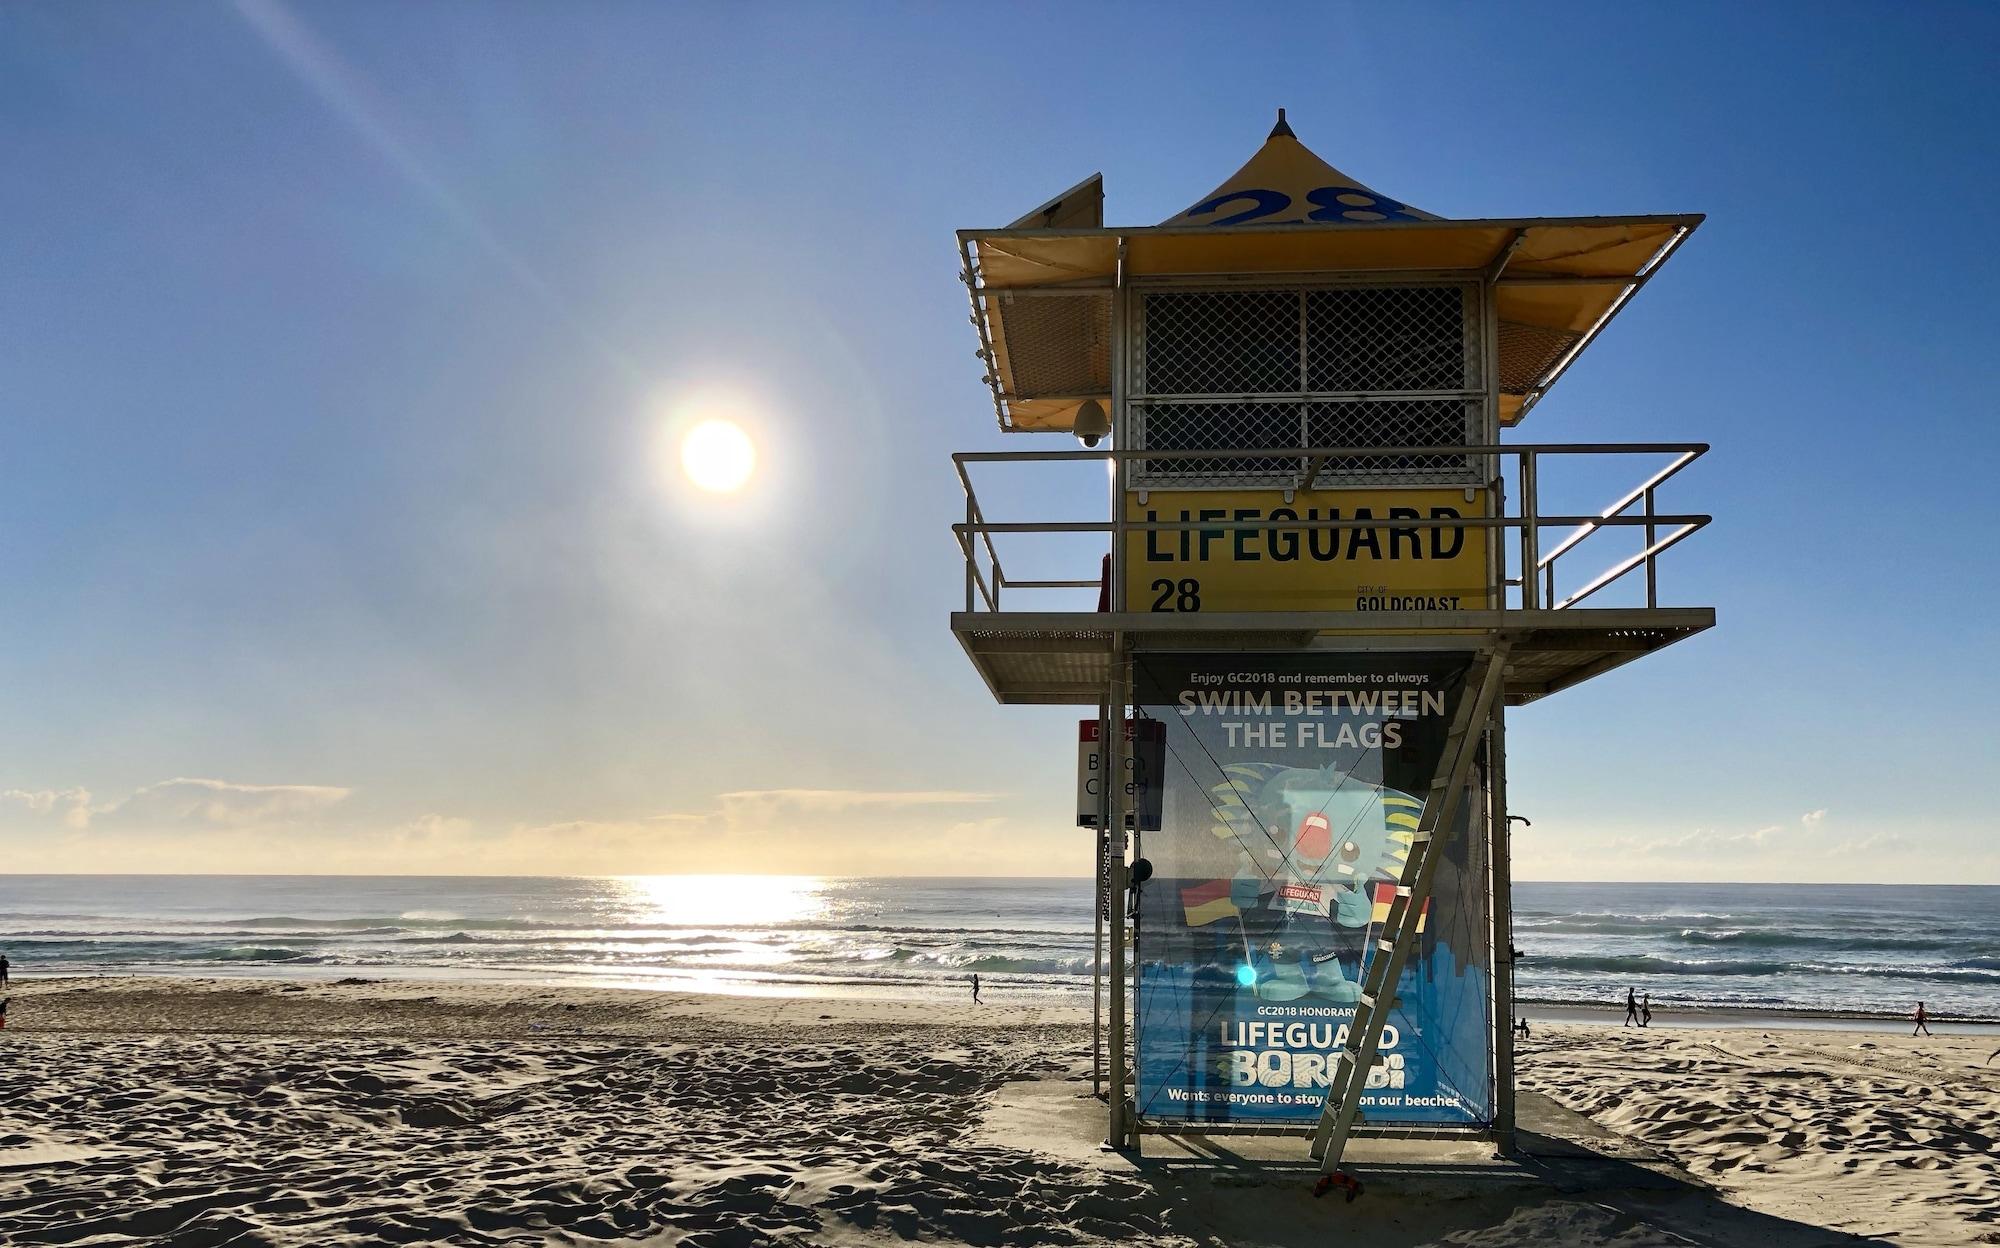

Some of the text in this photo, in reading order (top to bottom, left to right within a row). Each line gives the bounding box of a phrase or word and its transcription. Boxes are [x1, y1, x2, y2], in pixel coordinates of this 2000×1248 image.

[1187, 187, 1424, 226] 28
[1147, 508, 1465, 562] LIFEGUARD
[1151, 578, 1201, 613] 28
[1357, 586, 1390, 594] CITY OF
[1190, 671, 1429, 686] Enjoy GC2018 and remember to always
[1179, 690, 1445, 716] SWIM BETWEEN
[1221, 722, 1403, 749] THE FLAGS
[1280, 886, 1320, 901] LIFEGUARD
[1257, 1006, 1358, 1018] GC2018 HONORARY
[1220, 1021, 1400, 1050] LIFEGUAD
[1167, 1088, 1211, 1101] Wants
[1214, 1092, 1275, 1106] everyone
[1277, 1092, 1292, 1104] to
[1295, 1094, 1323, 1107] stay
[1359, 1096, 1375, 1106] on
[1379, 1096, 1402, 1107] our
[1405, 1094, 1460, 1107] beaches
